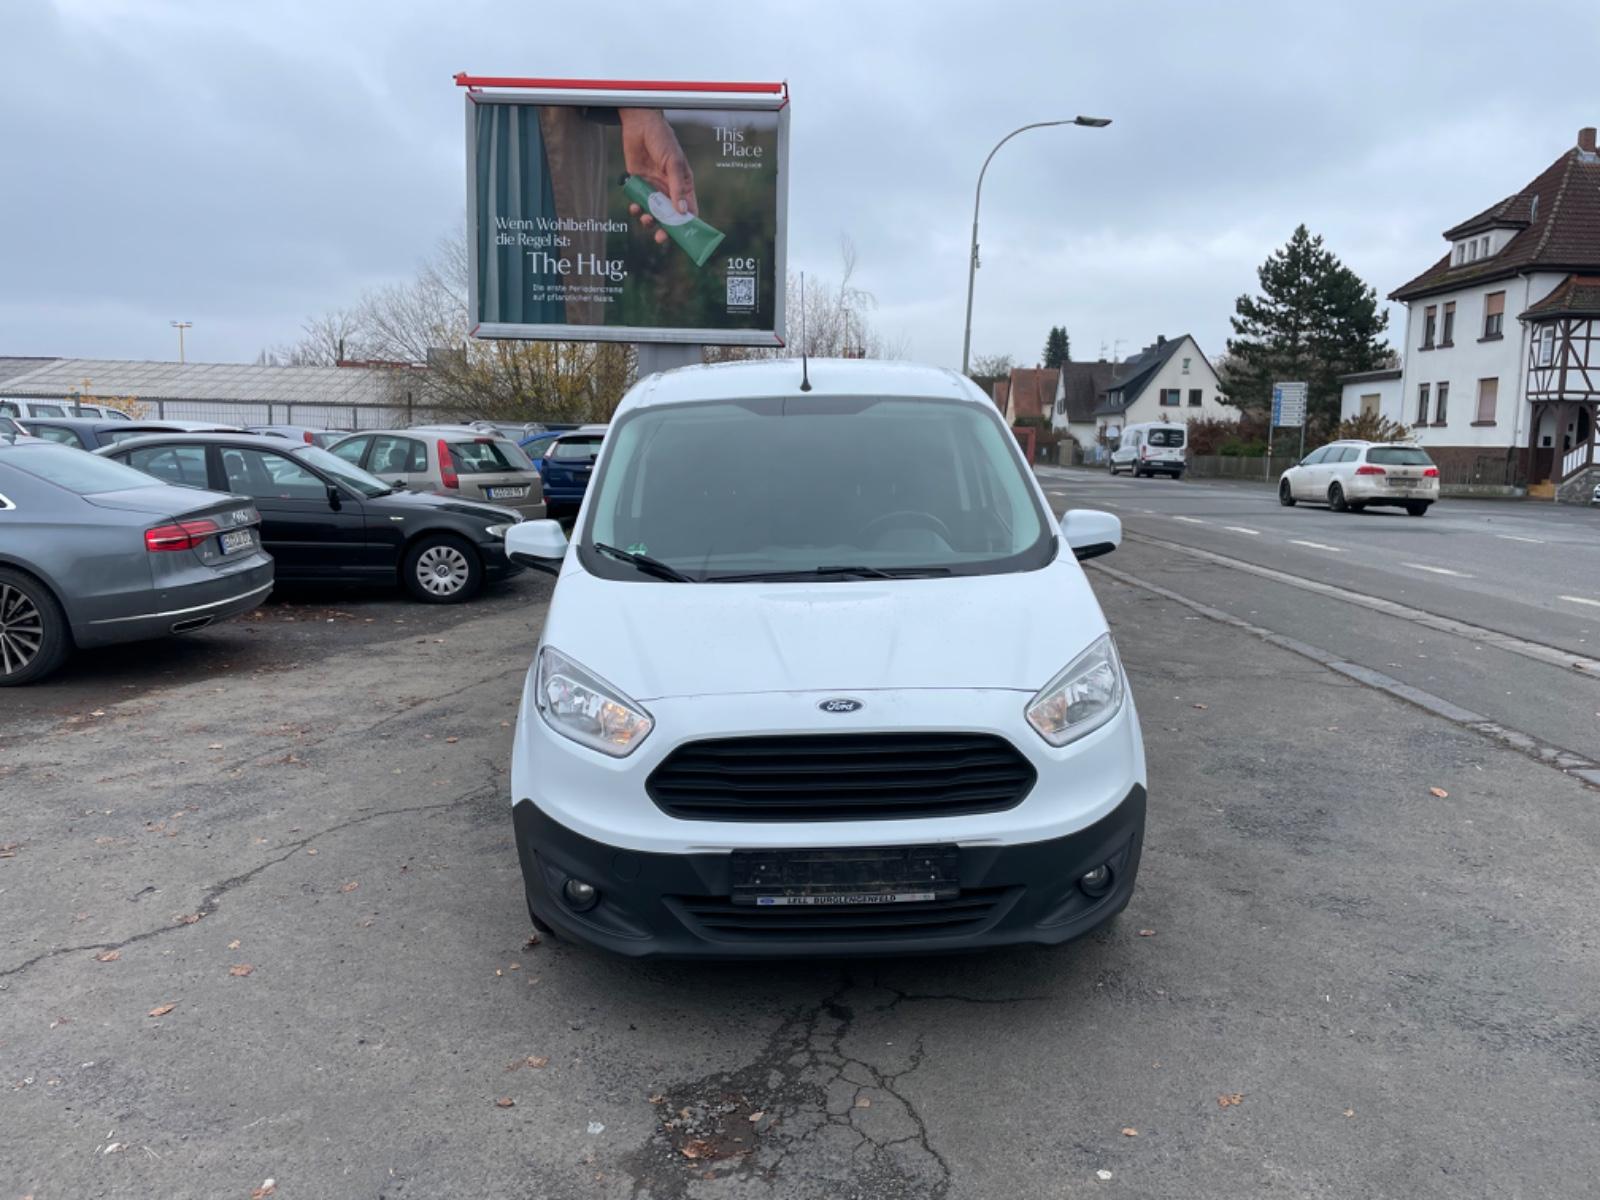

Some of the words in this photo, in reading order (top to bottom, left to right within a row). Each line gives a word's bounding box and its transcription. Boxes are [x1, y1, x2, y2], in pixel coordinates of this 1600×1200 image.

[712, 126, 744, 142] This
[722, 142, 763, 158] Place
[495, 217, 534, 230] Wenn
[536, 217, 628, 232] Wohlbefinden
[496, 232, 515, 246] die
[518, 233, 552, 248] Regel
[526, 251, 571, 275] The
[577, 252, 628, 282] Hug.
[727, 257, 744, 270] 10
[745, 257, 755, 270] €
[826, 700, 855, 711] Ford
